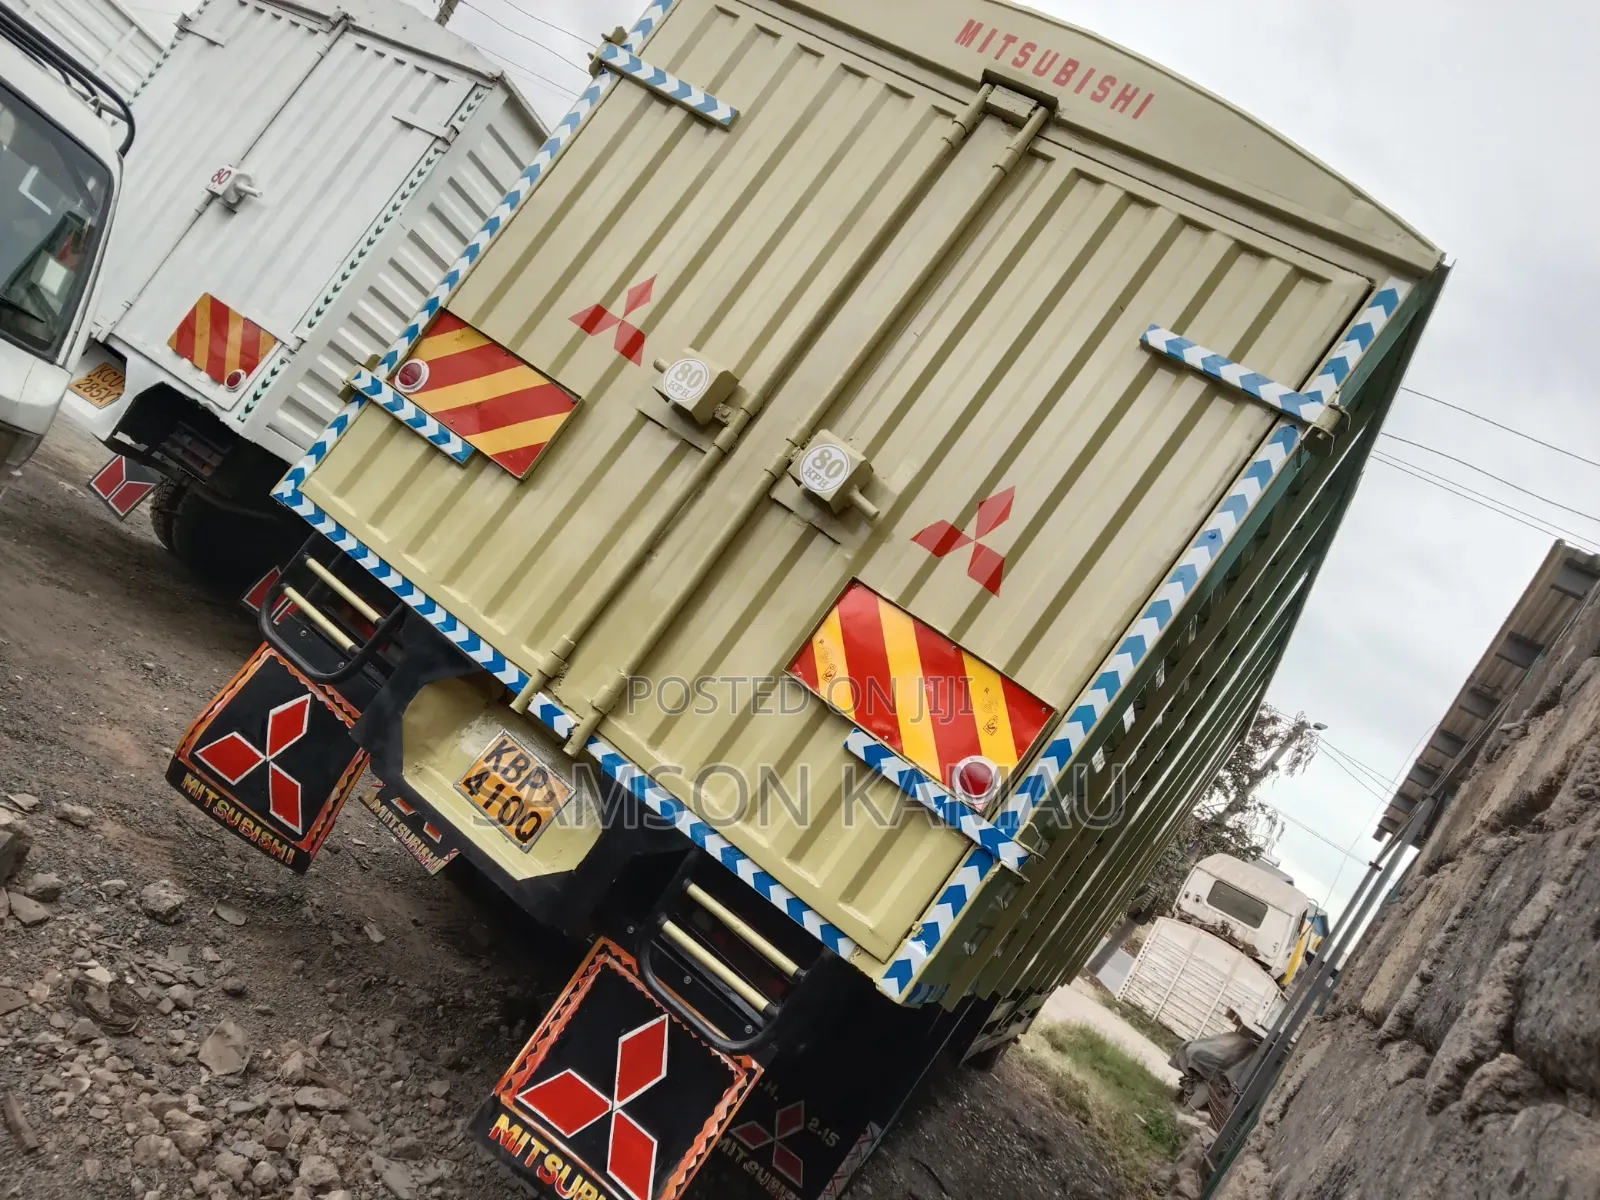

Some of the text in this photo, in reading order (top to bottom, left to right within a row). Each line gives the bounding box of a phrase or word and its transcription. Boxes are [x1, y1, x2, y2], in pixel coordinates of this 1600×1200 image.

[955, 19, 1154, 119] MITSUBISHI
[211, 168, 232, 185] 80
[92, 366, 125, 388] KCU
[667, 380, 690, 398] KPH
[674, 362, 704, 389] 80
[804, 466, 829, 488] KPH
[811, 449, 845, 479] 80
[181, 772, 296, 865] MITSUBISHI
[463, 771, 543, 843] 410Q
[368, 798, 443, 873] MITSUBISHI
[807, 1117, 840, 1148] 2.15
[488, 1113, 607, 1200] MITSUB
